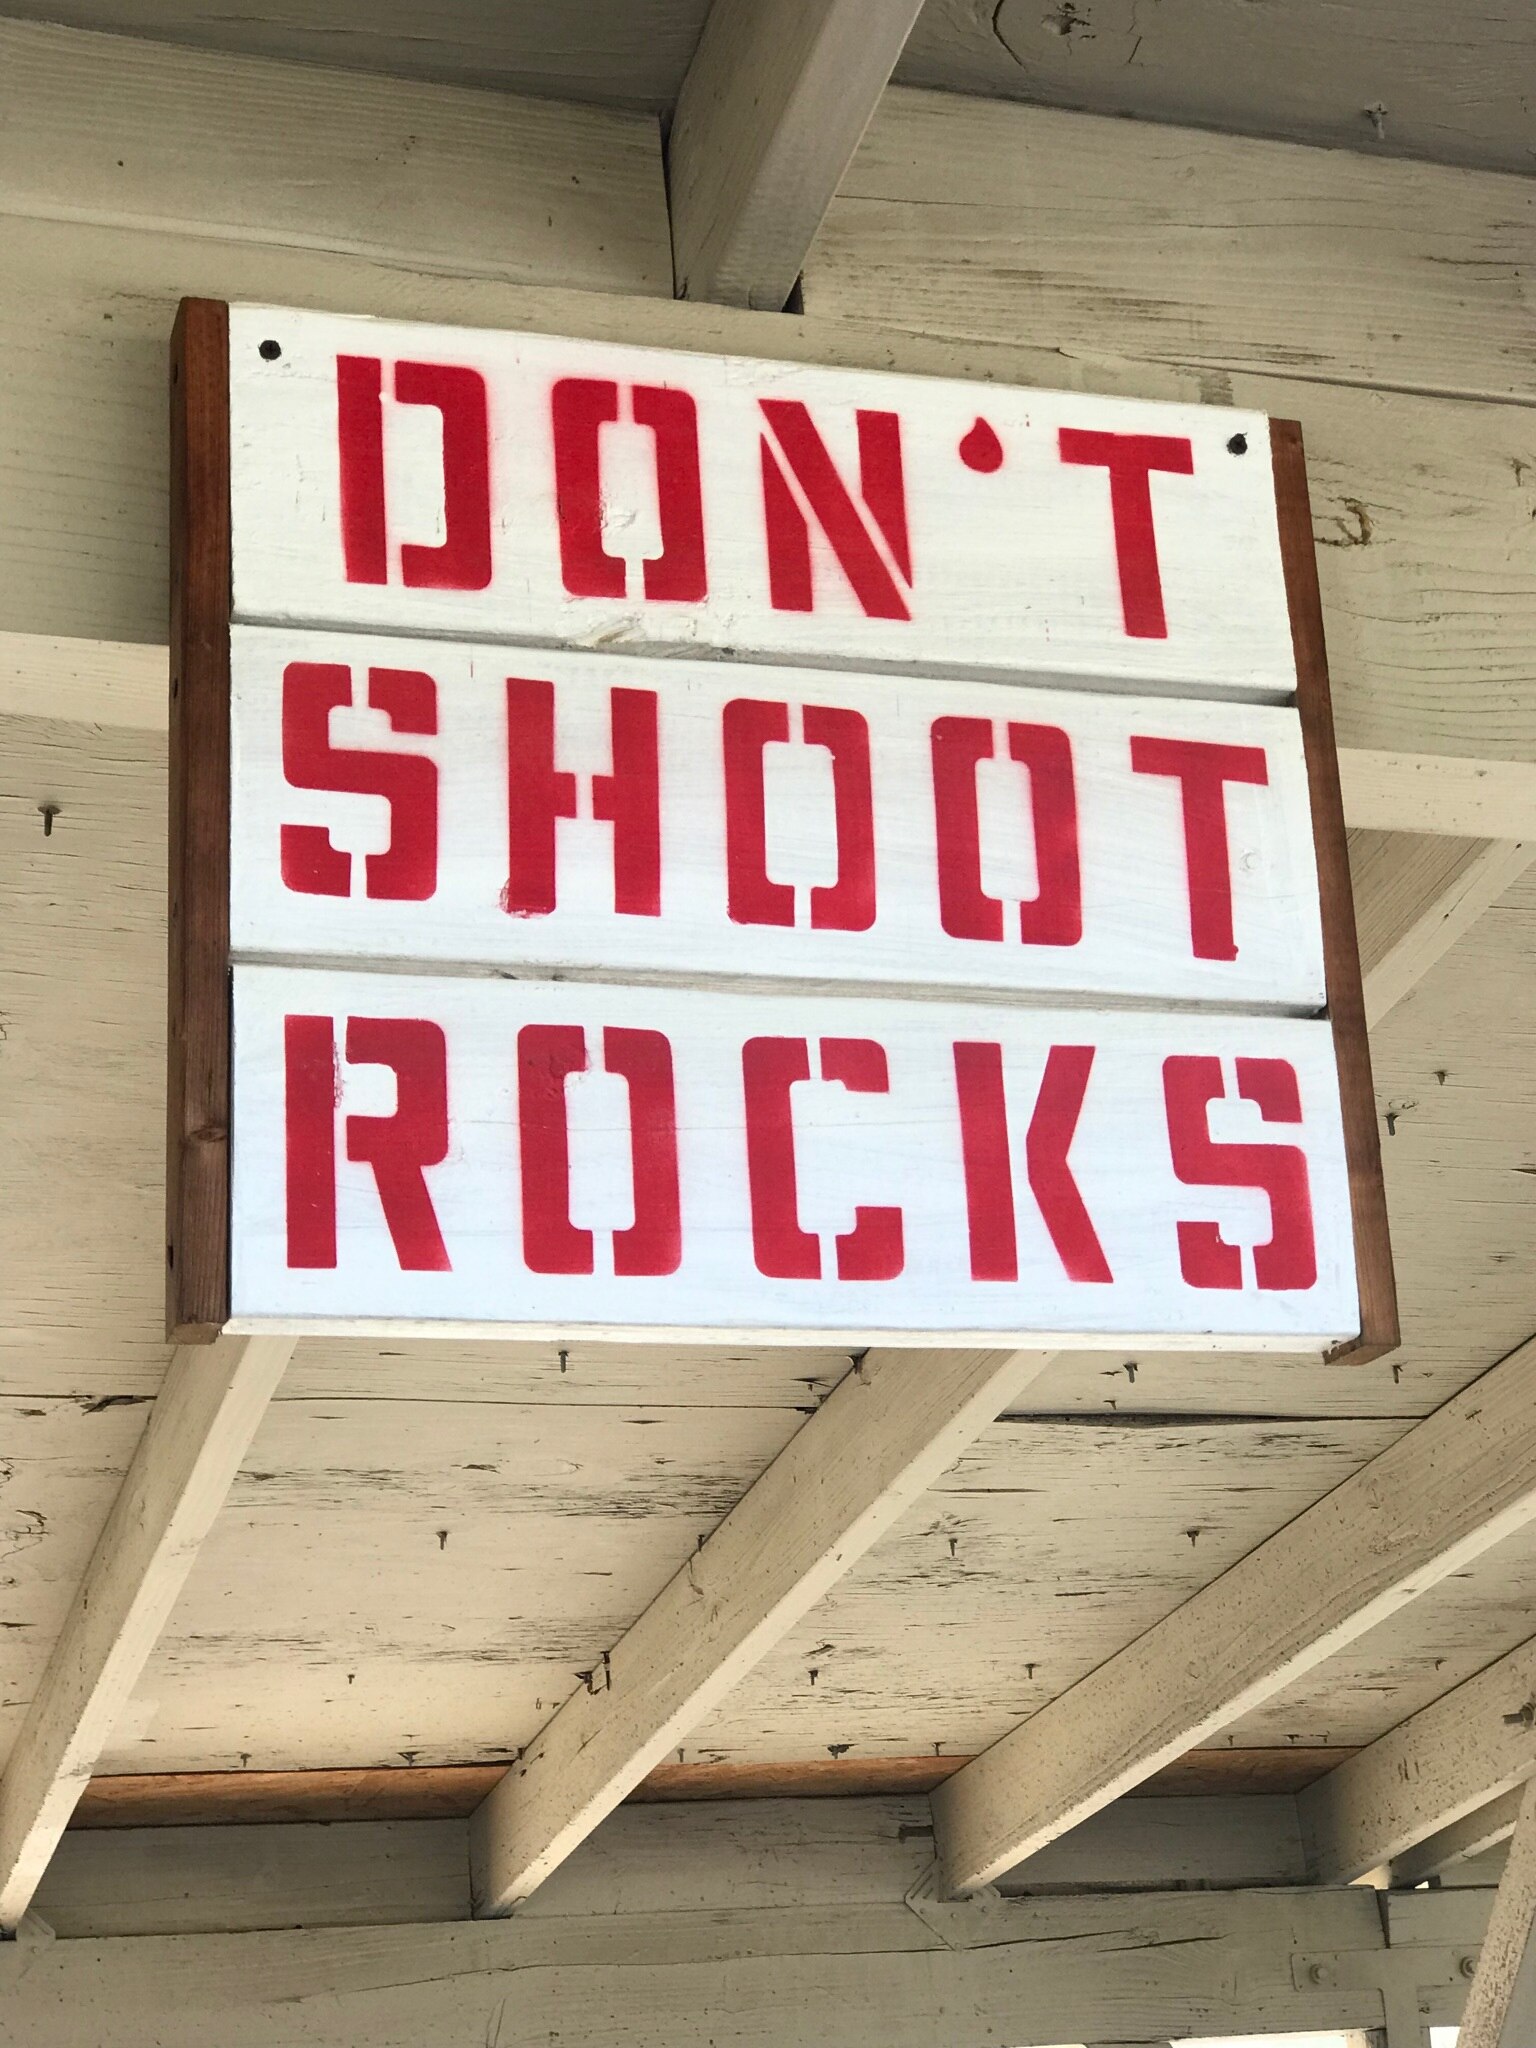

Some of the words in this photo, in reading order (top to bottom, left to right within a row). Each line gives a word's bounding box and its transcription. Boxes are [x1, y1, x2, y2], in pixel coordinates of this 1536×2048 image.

[336, 354, 1195, 640] DON'T
[281, 662, 1269, 962] SHOOT
[284, 1014, 1318, 1291] ROCKS
